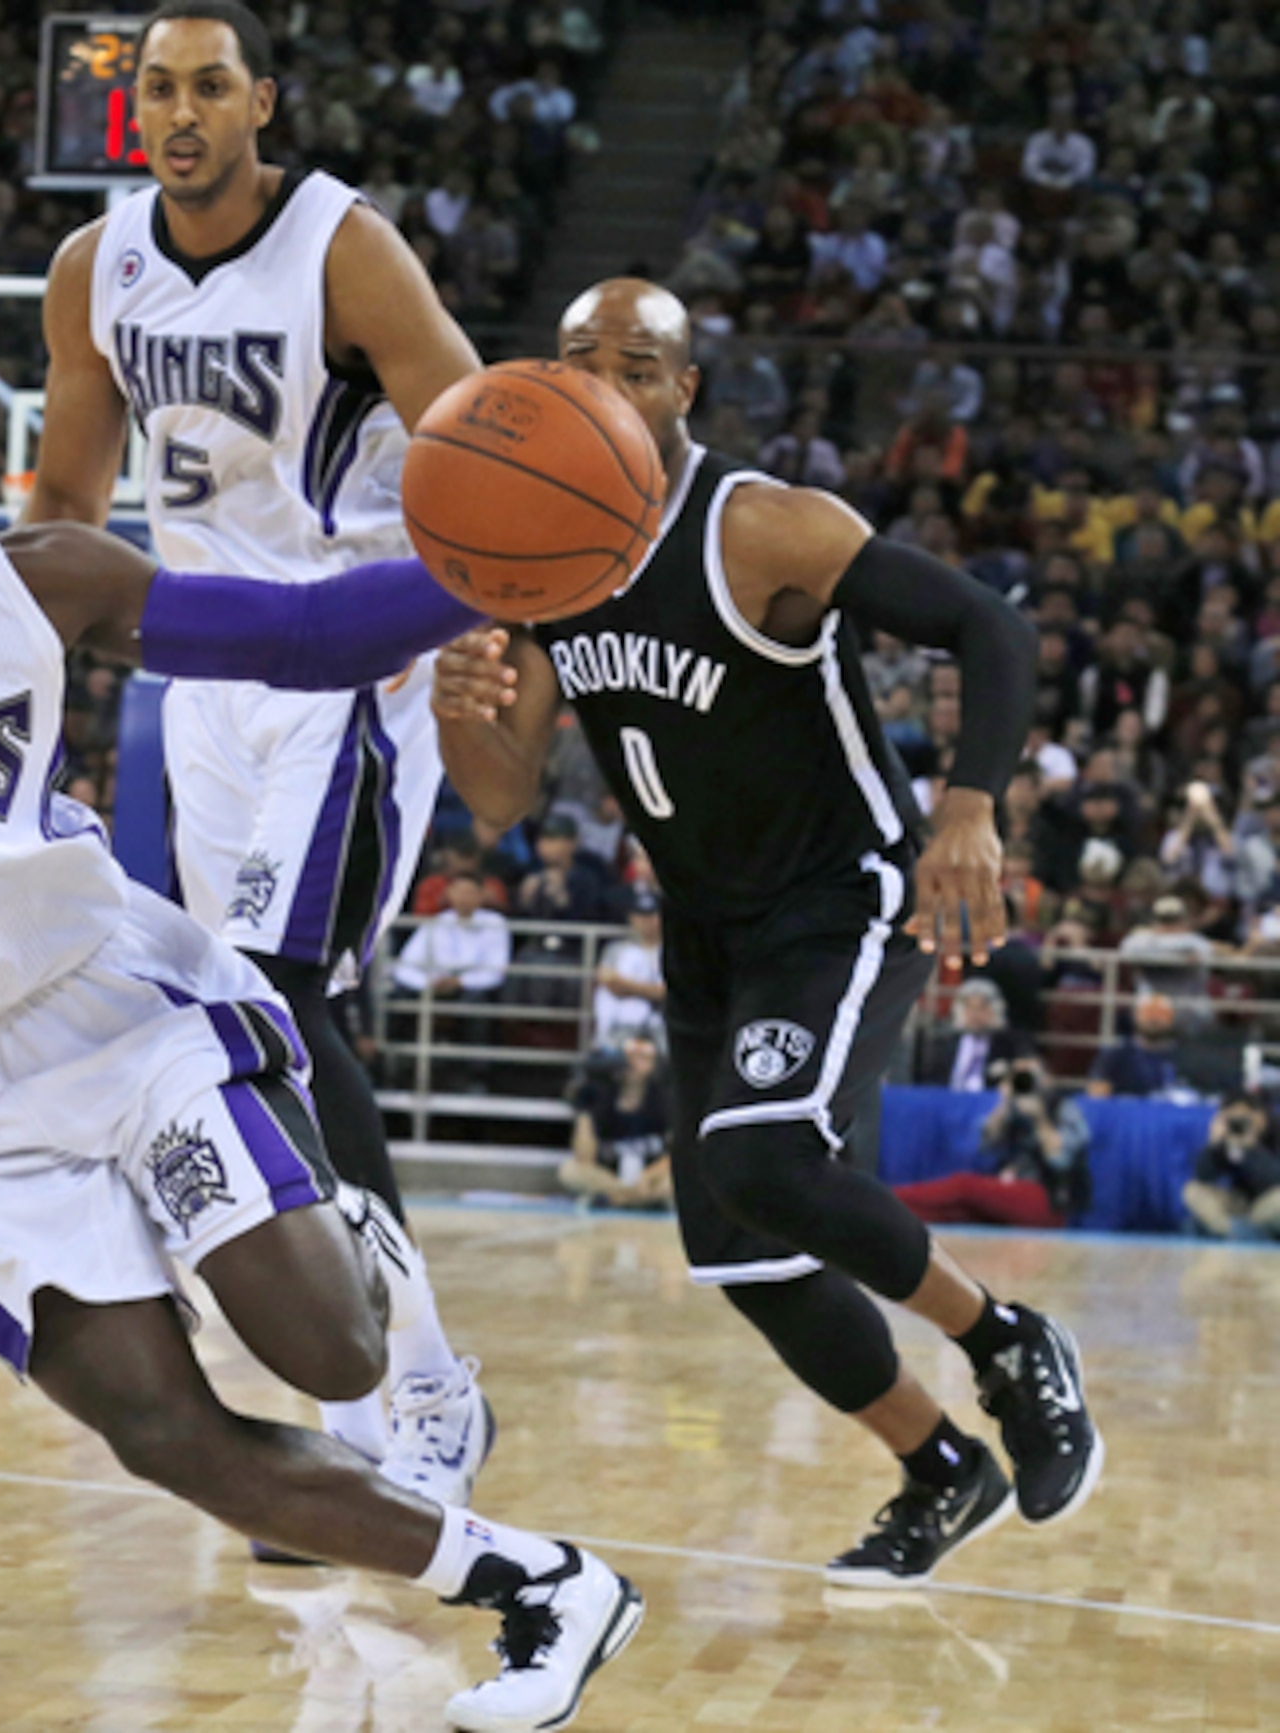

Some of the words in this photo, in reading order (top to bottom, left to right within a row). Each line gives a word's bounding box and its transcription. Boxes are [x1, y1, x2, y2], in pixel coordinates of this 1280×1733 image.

[113, 320, 287, 447] KINGS
[162, 437, 216, 509] 5
[549, 631, 727, 714] ROOKLYN
[620, 726, 675, 820] 0
[738, 1024, 815, 1058] NETS
